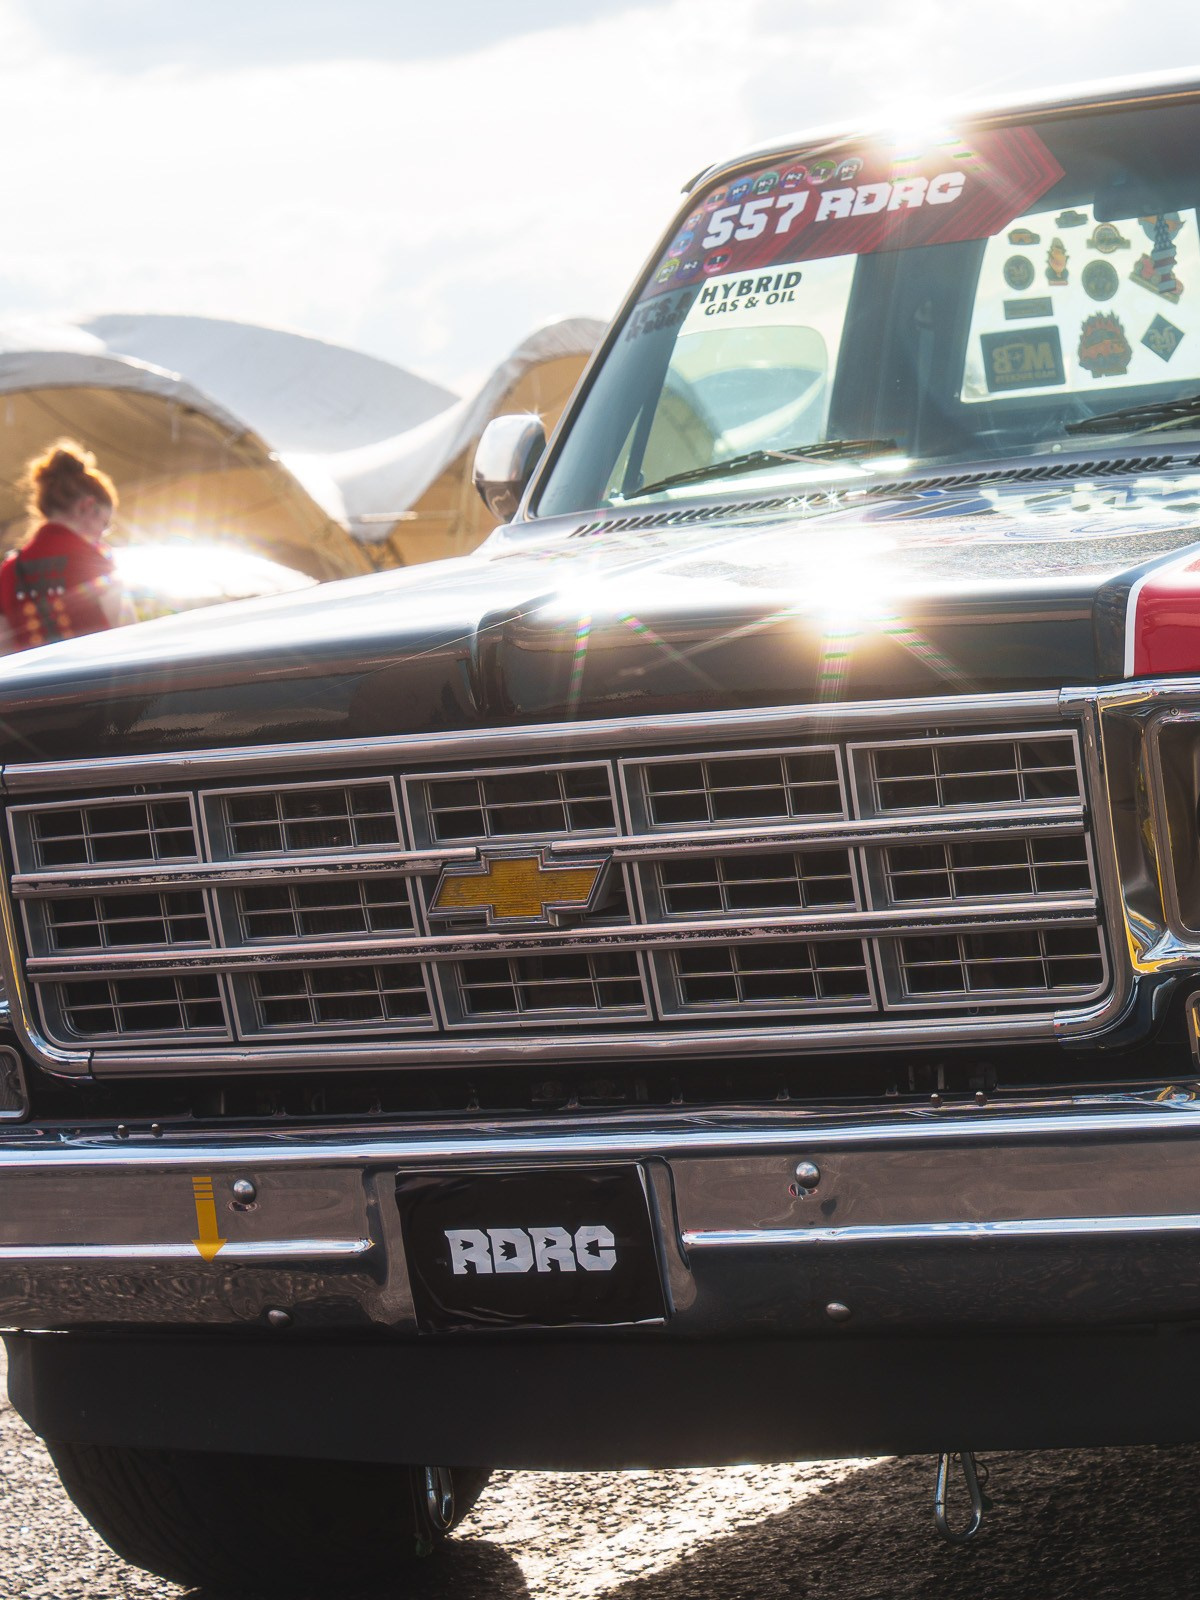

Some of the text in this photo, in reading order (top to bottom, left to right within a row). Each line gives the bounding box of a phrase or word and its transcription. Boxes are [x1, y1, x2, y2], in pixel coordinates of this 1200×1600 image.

[702, 172, 966, 249] 557 RDRC
[700, 271, 802, 304] HYBRID
[704, 290, 795, 316] GAS & OIL
[444, 1225, 617, 1274] RDRC
